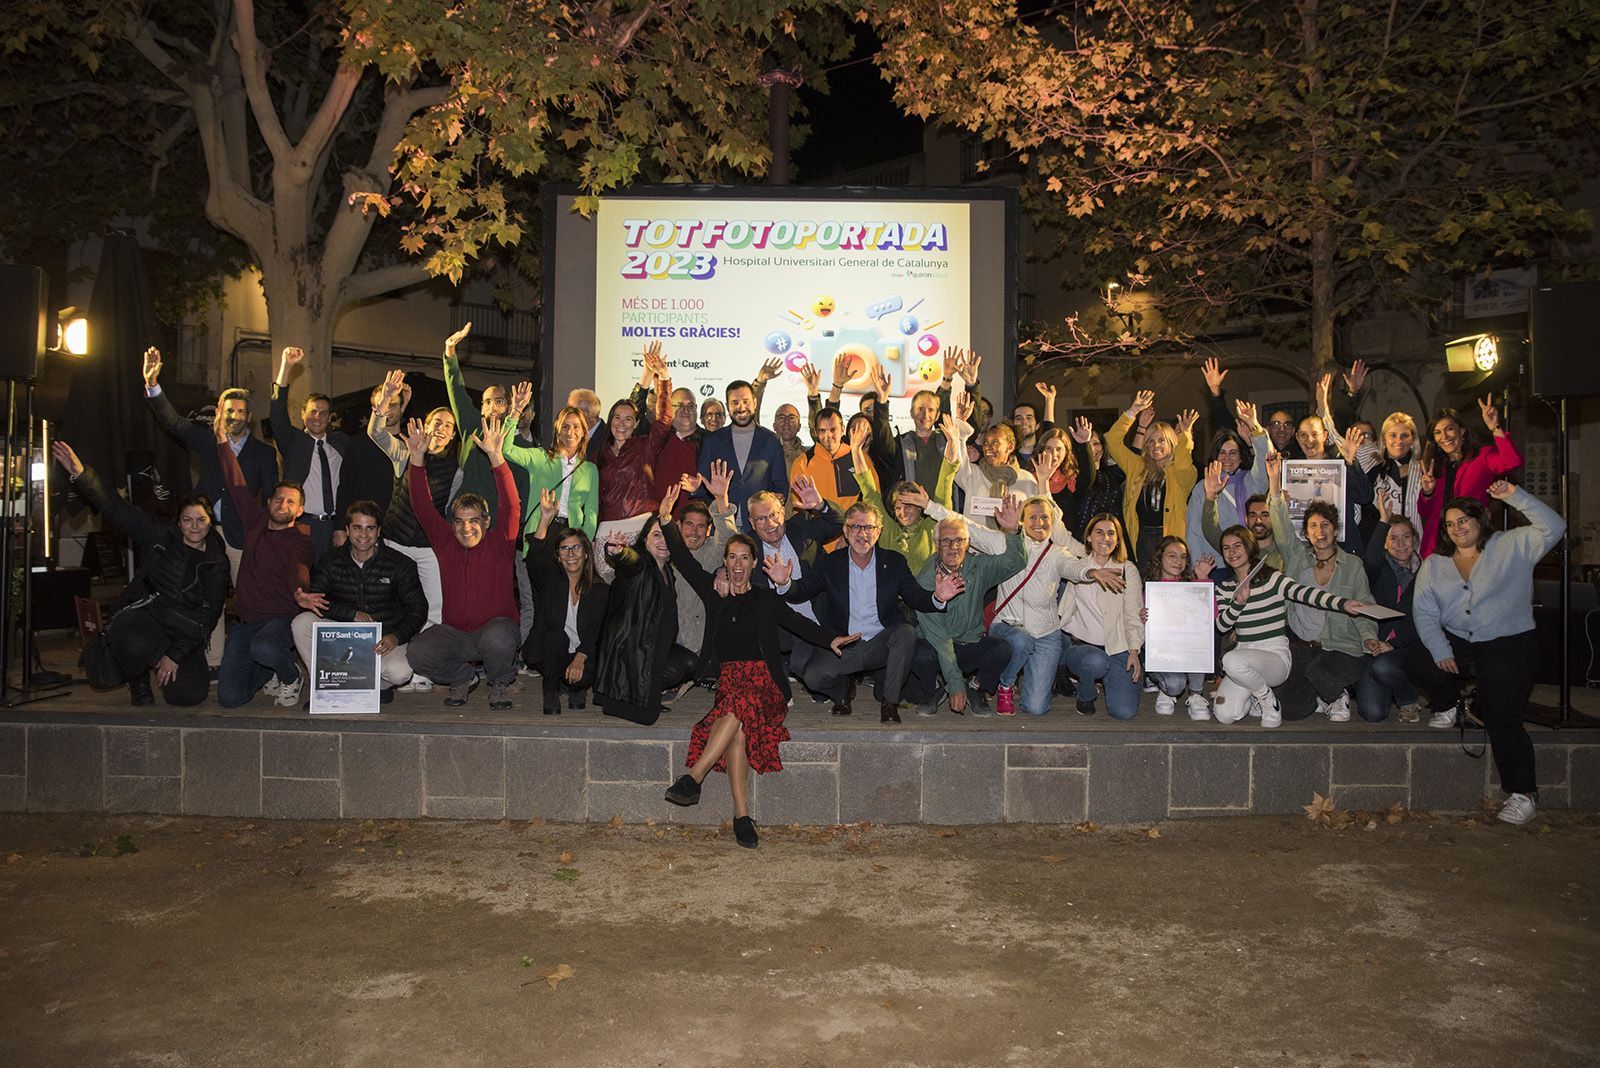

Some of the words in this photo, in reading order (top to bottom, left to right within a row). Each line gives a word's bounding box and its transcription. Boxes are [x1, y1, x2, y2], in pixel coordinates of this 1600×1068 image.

[623, 219, 703, 249] TOT
[702, 219, 948, 251] FOTOPORTADA
[620, 250, 718, 280] 2023
[723, 256, 771, 267] Hospital
[774, 257, 836, 266] Universitari
[838, 257, 879, 267] General
[881, 258, 895, 267] de
[897, 258, 949, 269] Catalunya
[621, 296, 649, 310] MÉS
[651, 299, 668, 310] DE
[671, 299, 705, 310] 1.000
[621, 312, 709, 324] PARTICIPANTS
[621, 326, 676, 338] MOLTES
[679, 324, 741, 338] GRÀCIES!
[681, 360, 709, 369] Cugat
[354, 631, 373, 640] Cugat
[319, 670, 331, 680] 1r
